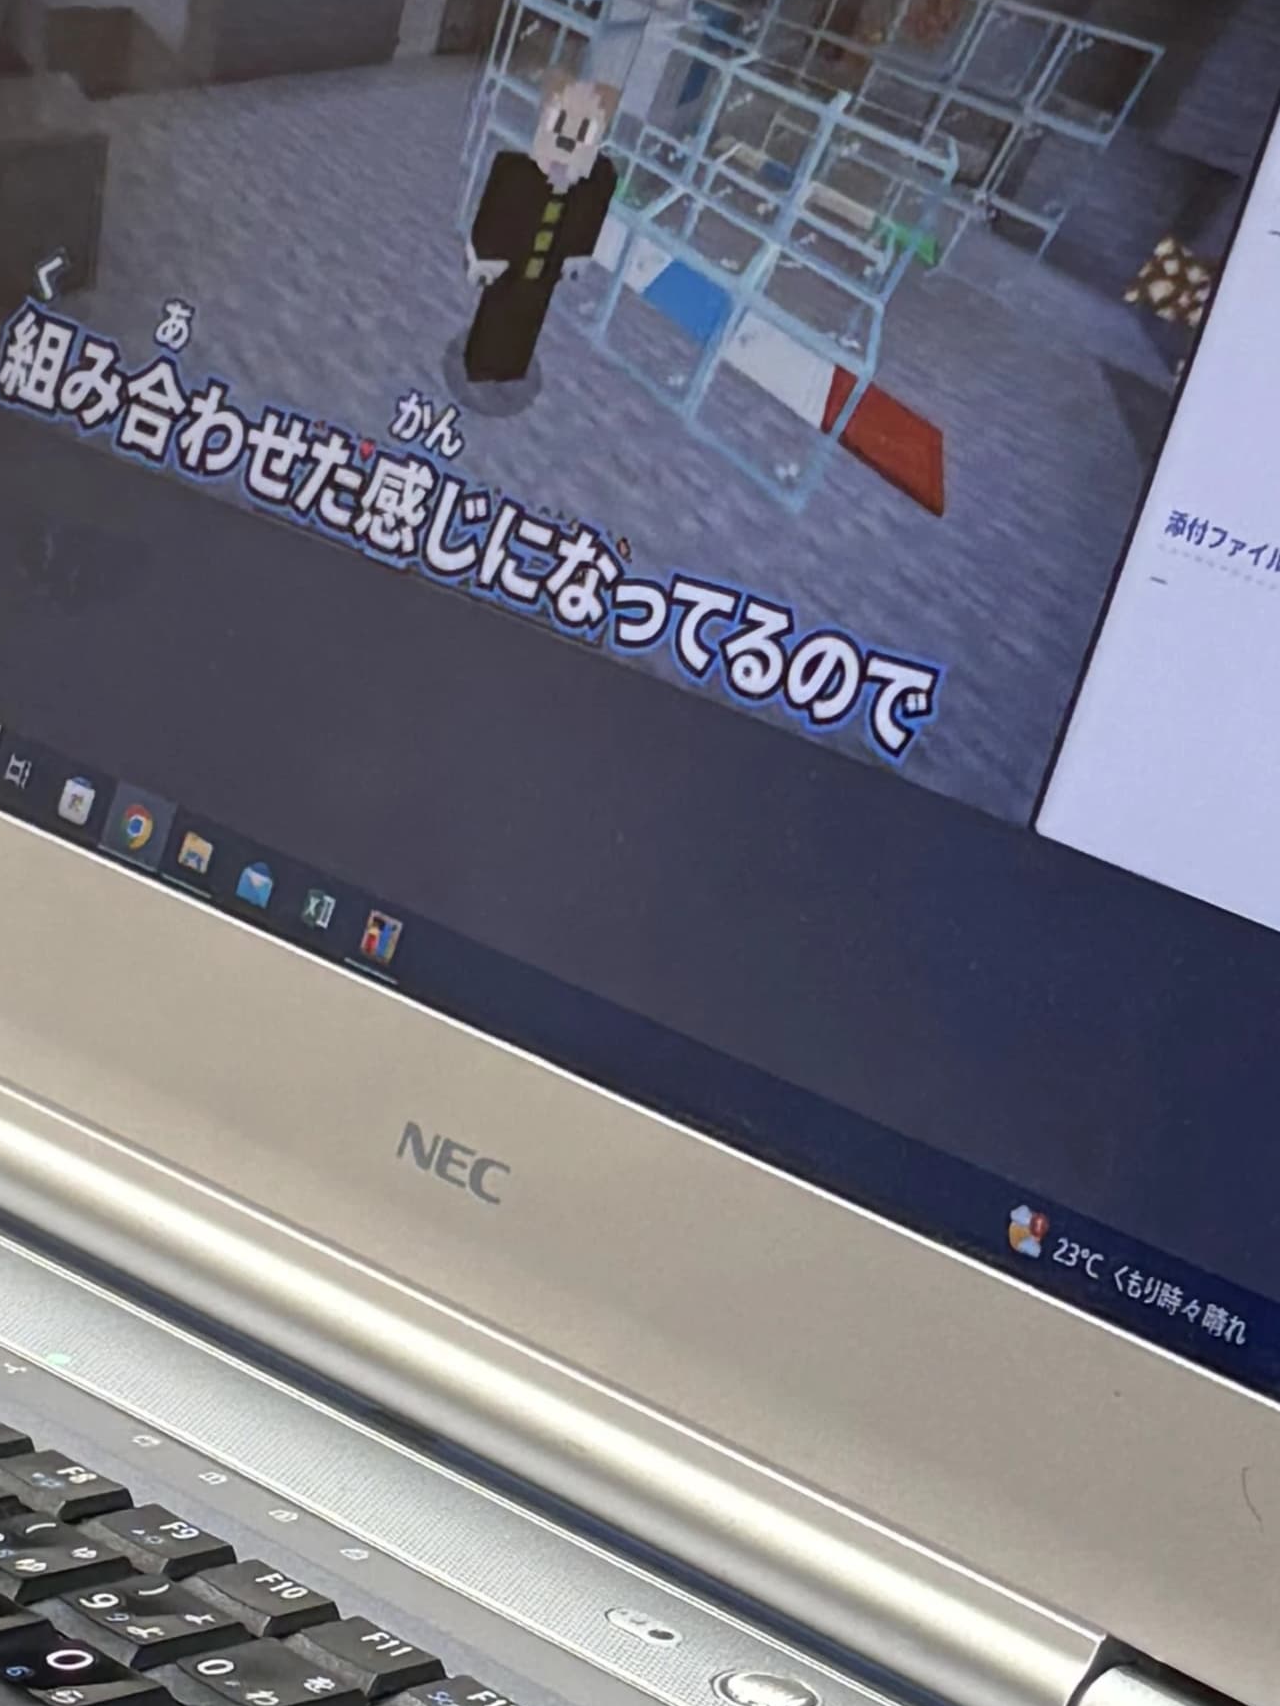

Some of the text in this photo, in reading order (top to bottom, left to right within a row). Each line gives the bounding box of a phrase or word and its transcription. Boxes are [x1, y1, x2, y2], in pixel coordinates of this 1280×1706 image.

[154, 298, 196, 351] あ
[390, 390, 465, 460] かん
[396, 1121, 512, 1206] NEC
[1114, 1264, 1247, 1348] くもり時々晴れ
[160, 1521, 199, 1541] F9
[256, 1571, 309, 1600] F10
[80, 1591, 119, 1610] 9
[45, 1648, 95, 1670] O
[361, 1632, 413, 1657] F11
